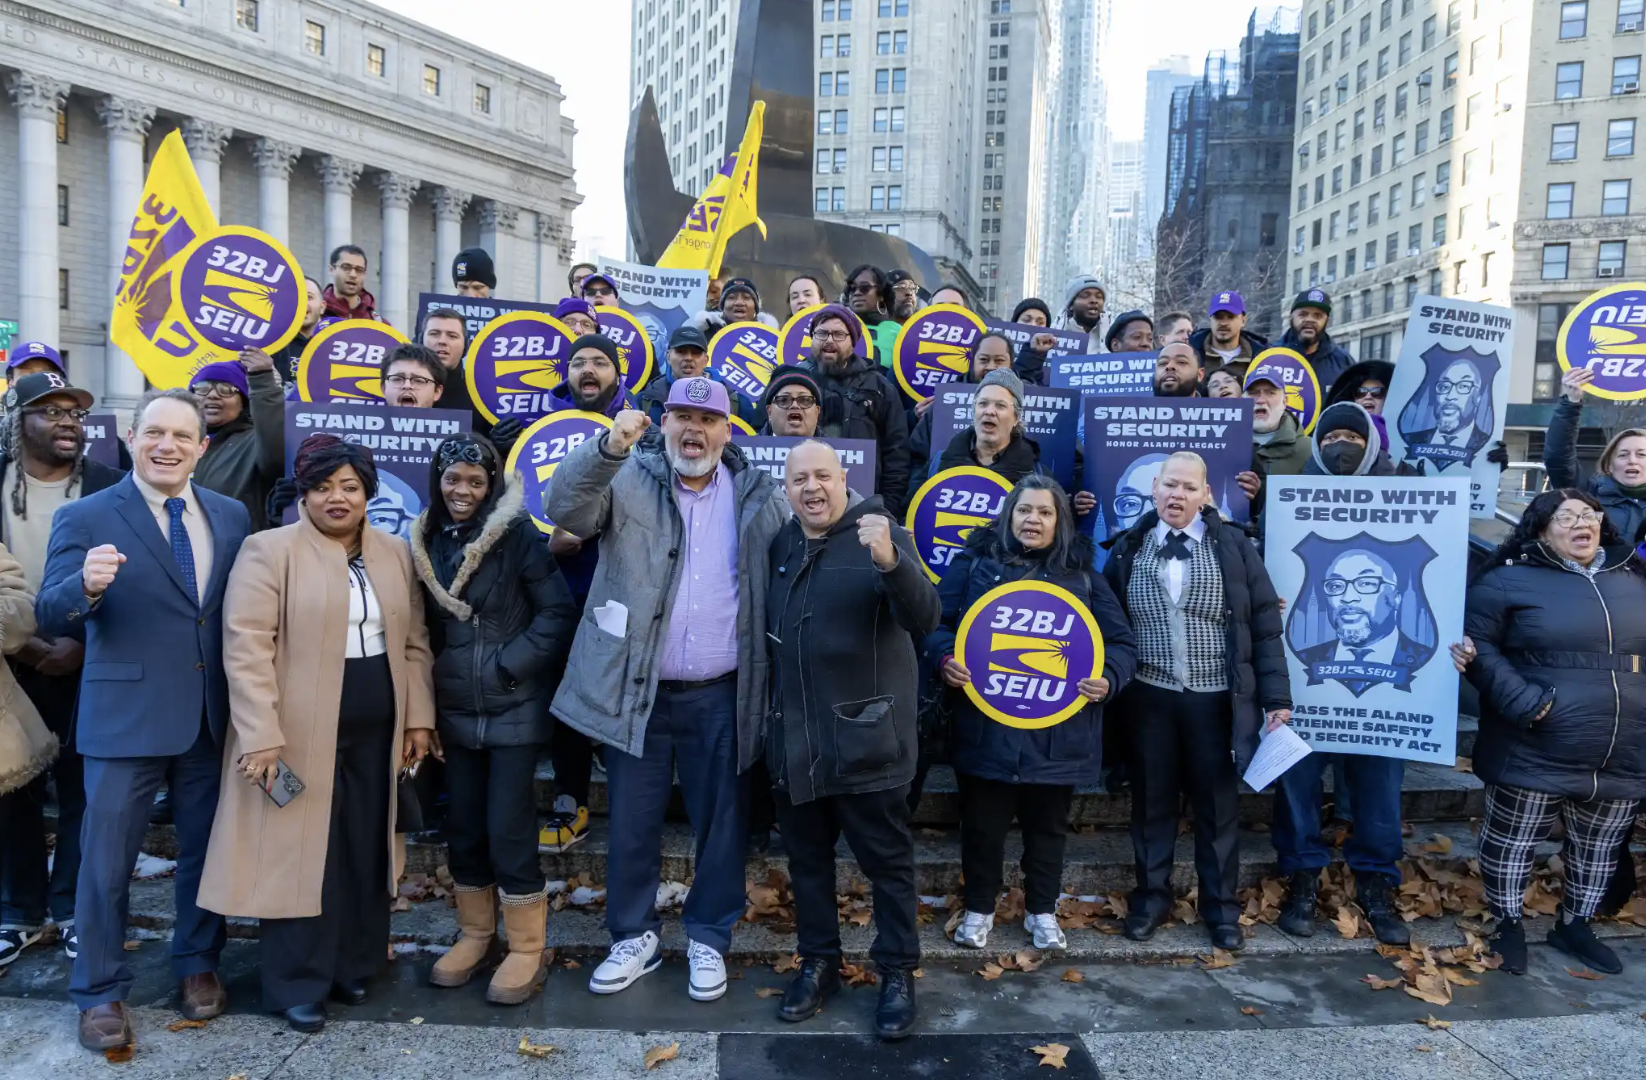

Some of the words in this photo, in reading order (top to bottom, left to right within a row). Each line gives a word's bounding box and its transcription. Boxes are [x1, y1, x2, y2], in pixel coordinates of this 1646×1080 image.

[76, 45, 166, 83] STATES
[193, 81, 276, 115] COURT
[301, 113, 366, 141] HOUSE
[206, 245, 286, 284] 32BJ
[604, 265, 657, 284] STAND
[660, 275, 701, 288] WITH
[194, 305, 270, 340] SEIU
[1420, 305, 1480, 323] STAND
[1483, 314, 1512, 330] WITH
[1590, 305, 1646, 324] EIU
[918, 321, 977, 345] 32BJ
[1427, 322, 1505, 343] SECURITY
[328, 340, 386, 364] 32B
[491, 335, 561, 357] 32BJ
[739, 330, 777, 364] 32B
[1059, 360, 1124, 374] STAND
[1585, 357, 1646, 378] 2BJ
[43, 372, 65, 388] B
[718, 363, 765, 397] SEIU
[1069, 372, 1154, 387] SECURIT
[1022, 395, 1071, 410] WITH
[295, 412, 385, 431] STAND
[391, 416, 459, 435] WITH
[1094, 406, 1174, 420] STAND
[1179, 407, 1243, 422] WITH
[1026, 427, 1057, 435] LEGACY
[1106, 423, 1228, 438] SECURITY
[742, 446, 792, 462] AND
[1106, 440, 1139, 448] HONOR
[1143, 441, 1186, 449] ALAND'S
[1415, 446, 1437, 454] 32BJ
[1449, 450, 1468, 458] SEIU
[935, 488, 1006, 516] 32BJ
[1278, 487, 1374, 504] STAND
[1380, 489, 1457, 506] WITH
[1294, 506, 1440, 524] SECURITY
[990, 605, 1075, 637] 32BJ
[1317, 665, 1347, 676] 32BJ
[1366, 667, 1398, 679] SEIU
[983, 673, 1067, 702] SEIU
[1333, 706, 1368, 718] THE
[1371, 709, 1434, 725] ALAND
[1362, 721, 1433, 738] SAFETY
[1315, 731, 1404, 748] SECURITY
[1407, 739, 1442, 753] ACT
